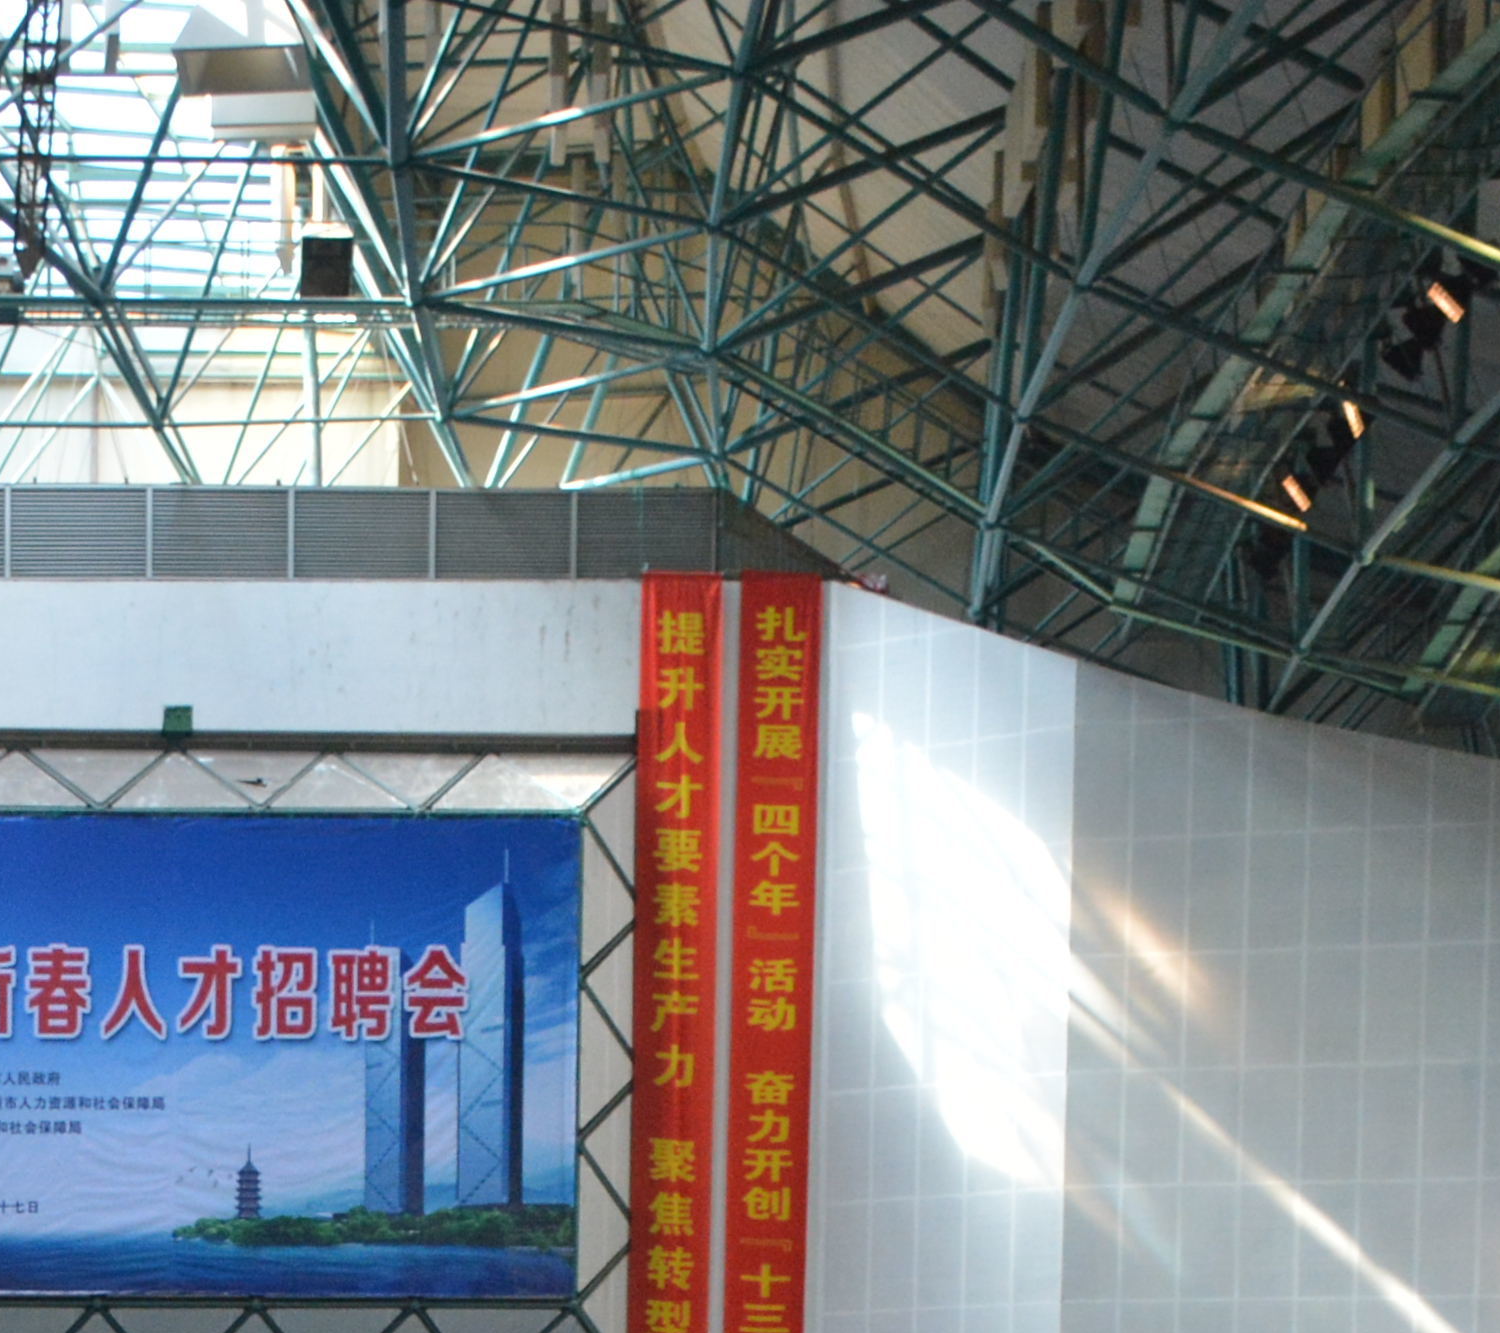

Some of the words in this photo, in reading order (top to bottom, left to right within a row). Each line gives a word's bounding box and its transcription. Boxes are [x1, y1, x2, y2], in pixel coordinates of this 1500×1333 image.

[650, 609, 706, 1089] 提升人才要素生产力
